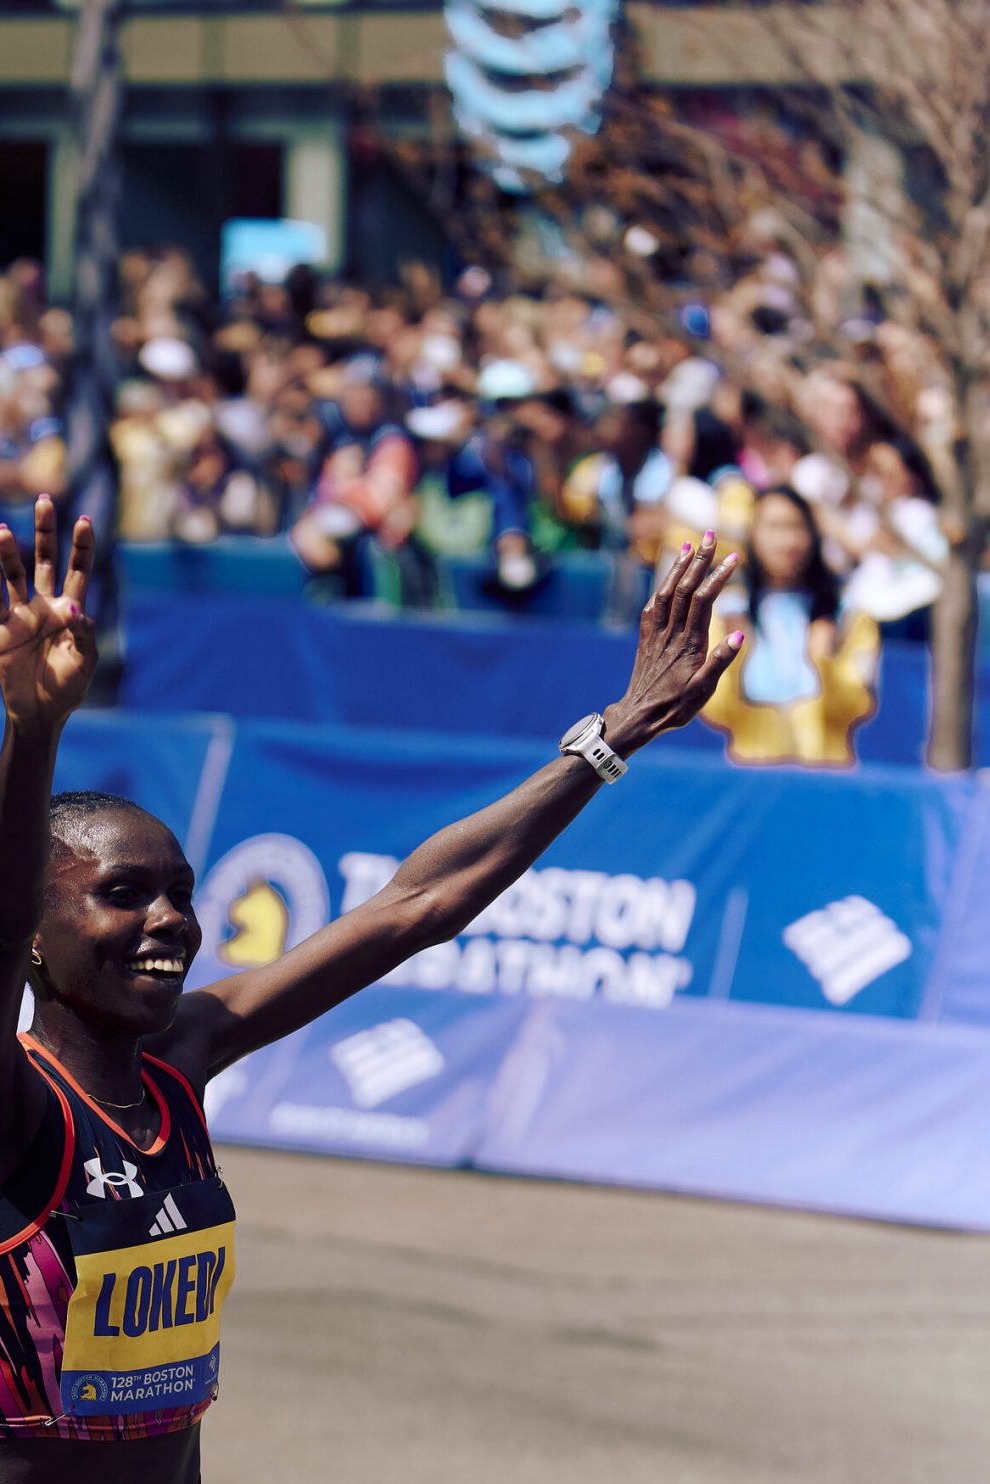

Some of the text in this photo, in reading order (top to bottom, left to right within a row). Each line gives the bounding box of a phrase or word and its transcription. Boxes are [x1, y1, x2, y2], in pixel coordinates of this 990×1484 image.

[462, 864, 697, 952] OSTON
[366, 937, 680, 1008] RATHON
[93, 1246, 226, 1338] LOKEDI
[110, 1378, 194, 1402] MARATHON
[111, 1375, 142, 1389] 128TH
[143, 1364, 194, 1385] BOSTON
